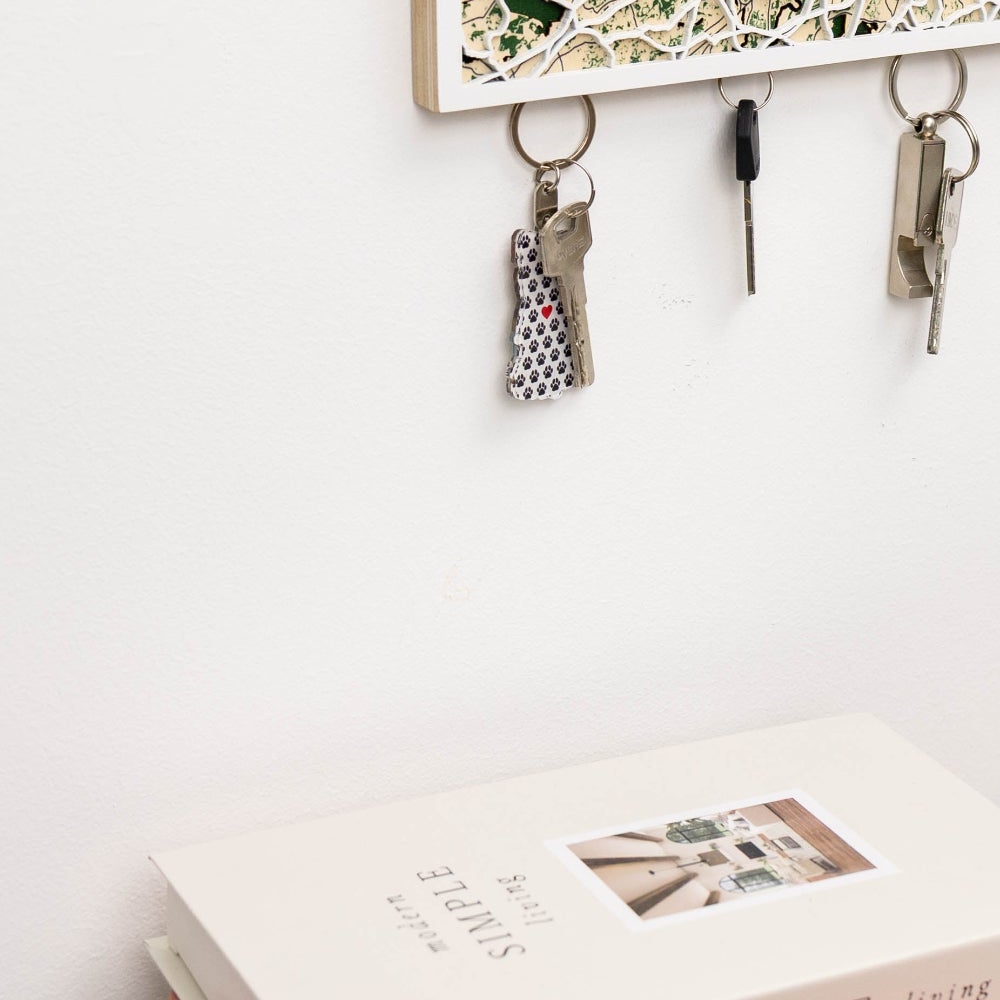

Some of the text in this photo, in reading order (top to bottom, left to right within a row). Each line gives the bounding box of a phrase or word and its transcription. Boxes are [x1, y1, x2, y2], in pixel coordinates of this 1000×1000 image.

[386, 894, 451, 953] modern
[416, 865, 526, 959] SIMPLE
[497, 873, 554, 927] living
